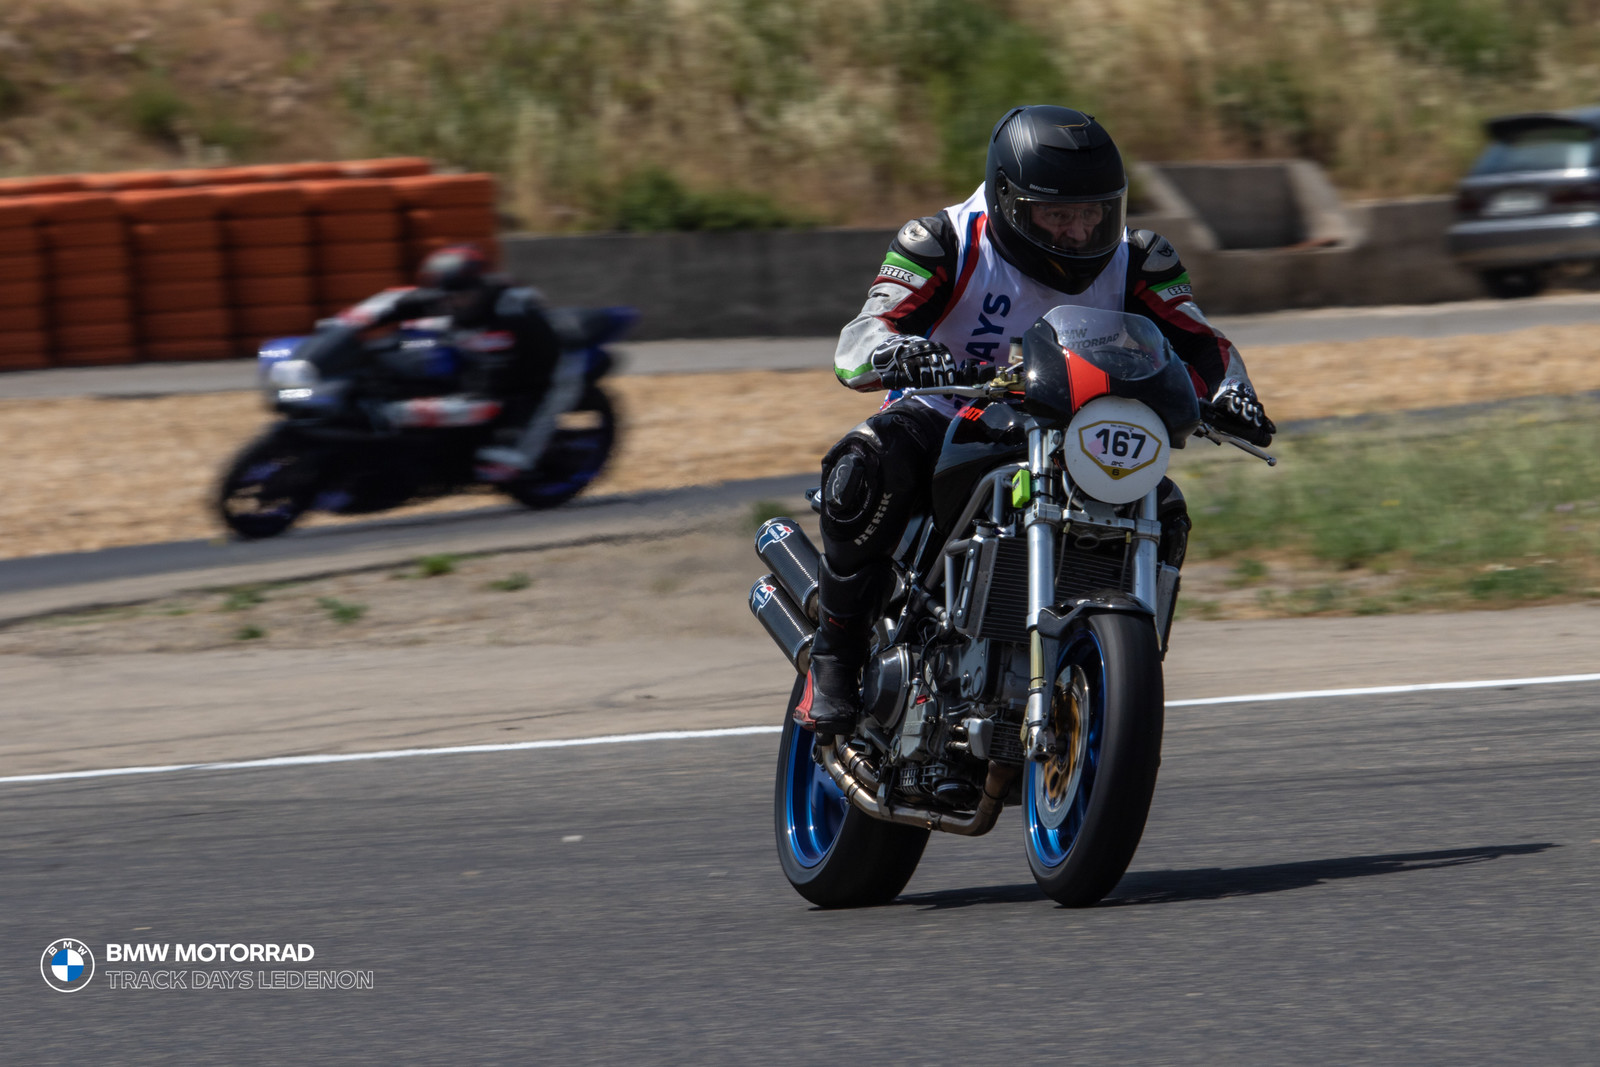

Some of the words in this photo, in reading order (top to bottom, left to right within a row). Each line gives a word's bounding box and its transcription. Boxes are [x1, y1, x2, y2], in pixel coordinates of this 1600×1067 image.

[962, 292, 1012, 365] AYS
[1095, 427, 1146, 460] 167
[853, 492, 893, 546] BERIK
